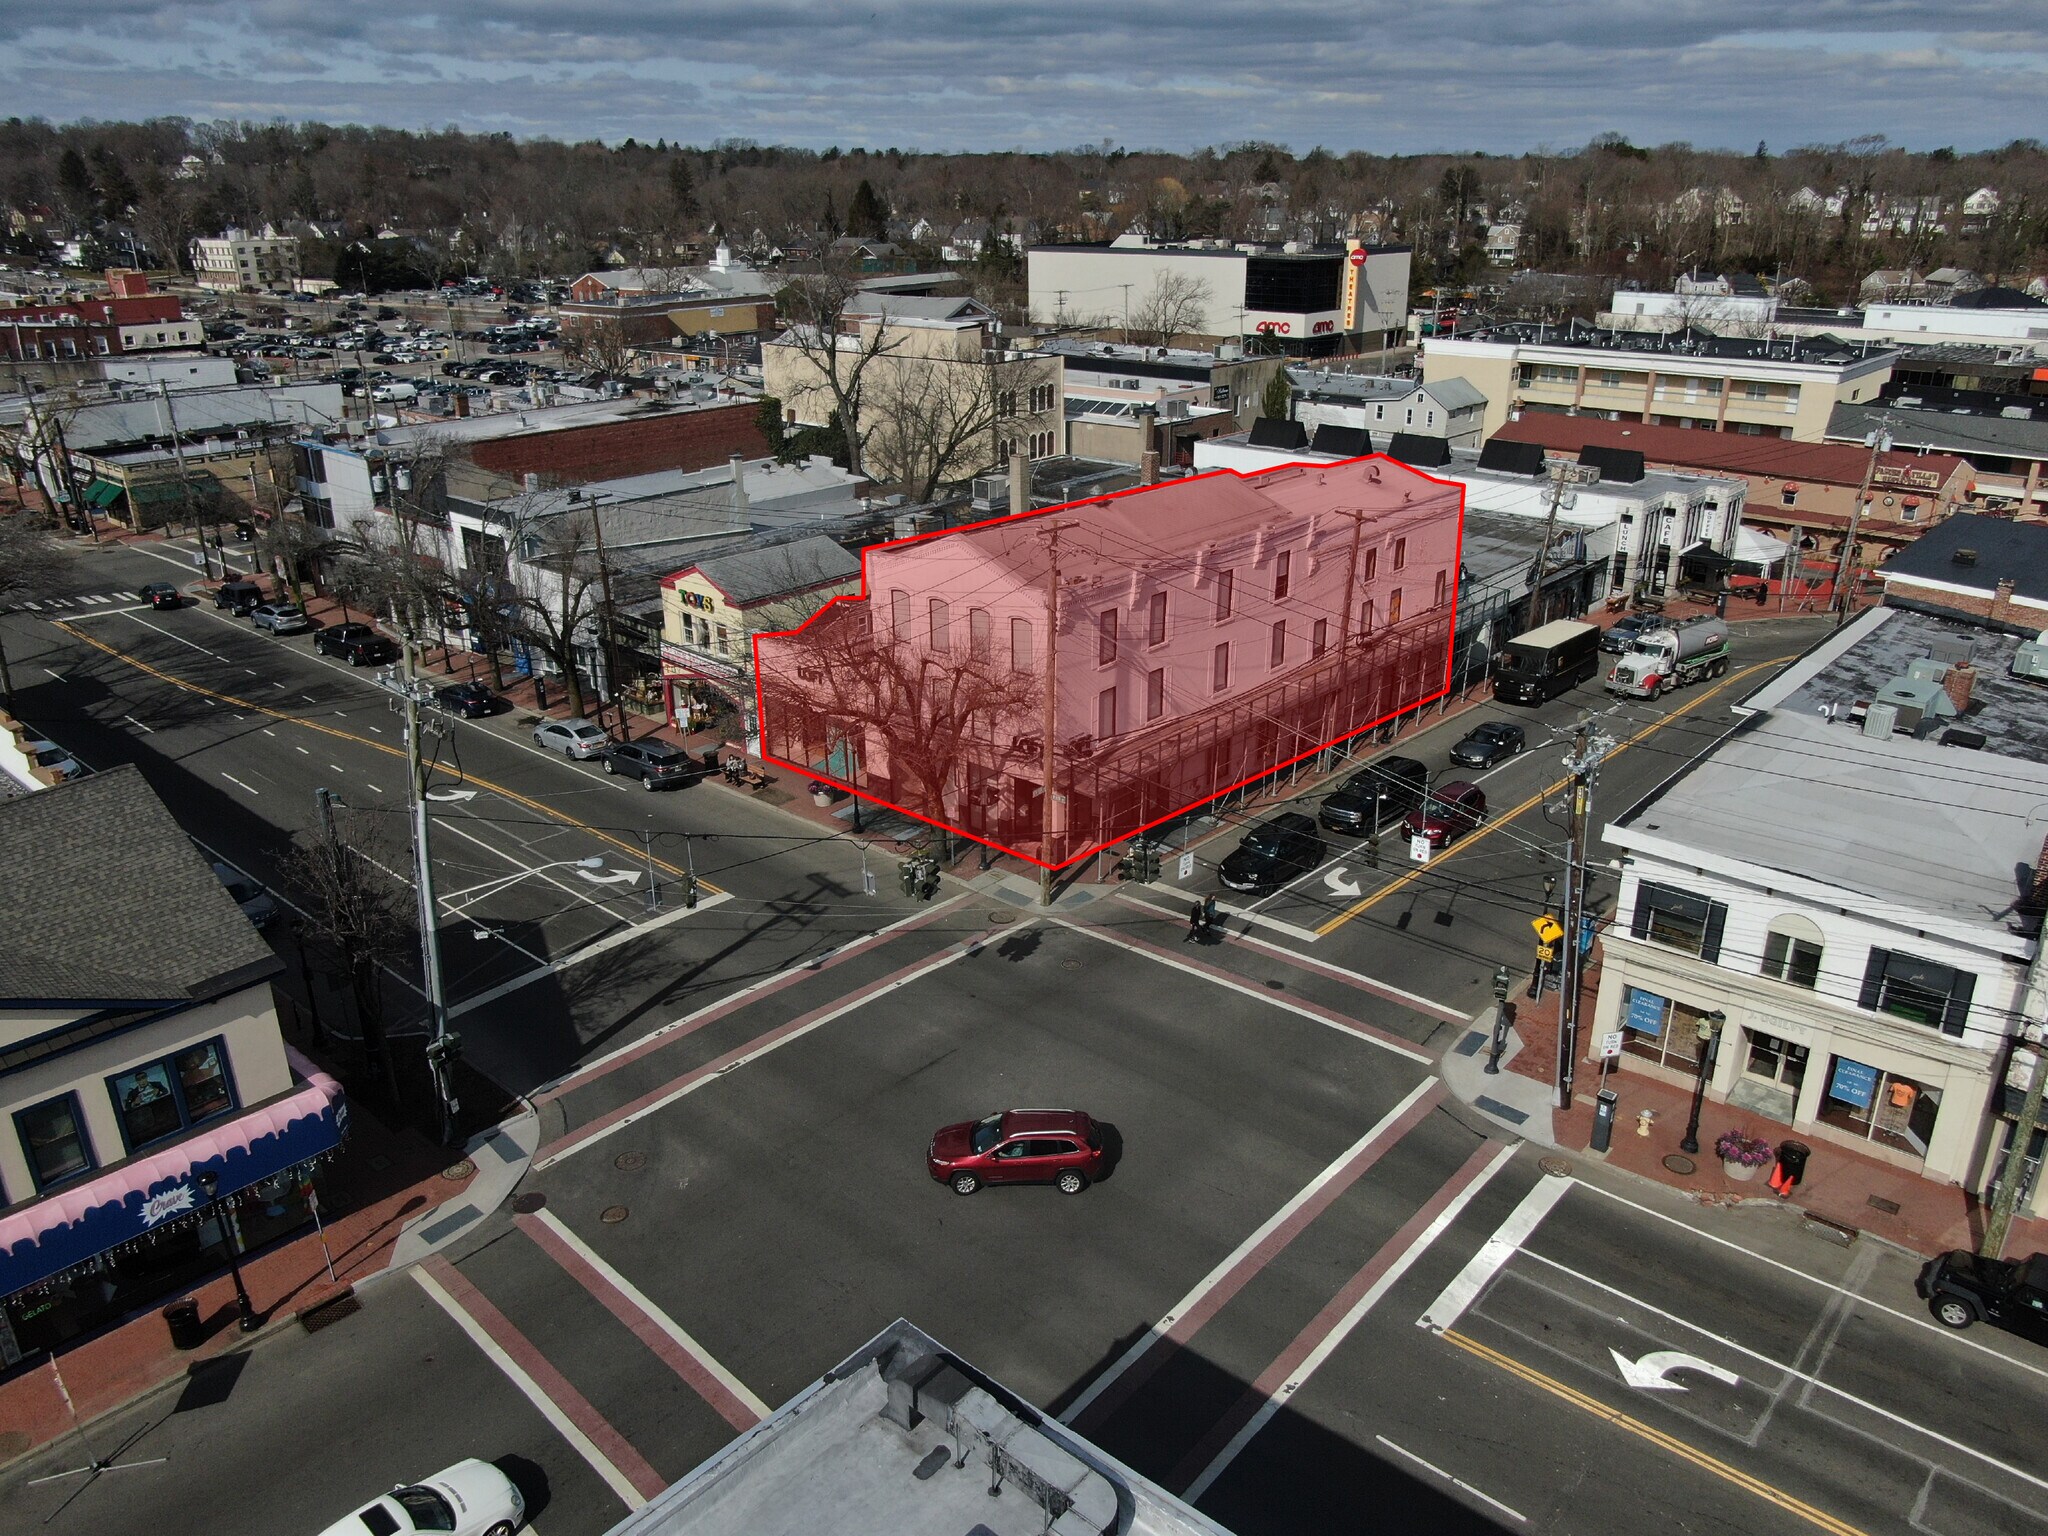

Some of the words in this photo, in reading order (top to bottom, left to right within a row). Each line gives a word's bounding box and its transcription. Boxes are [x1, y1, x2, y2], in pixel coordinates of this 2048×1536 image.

[1345, 269, 1354, 326] THEATRES
[1256, 321, 1291, 334] amc
[1312, 320, 1335, 335] amc
[1663, 517, 1672, 544] CAFE
[1704, 511, 1712, 537] COFFEE
[1620, 523, 1629, 551] LUNCH
[678, 588, 714, 614] TOYS
[1538, 947, 1551, 957] 20
[1643, 1017, 1657, 1025] OFF
[1837, 1068, 1872, 1082] CLEARANCE
[1847, 1066, 1864, 1074] FINAL
[1835, 1083, 1850, 1092] 70%
[1850, 1088, 1867, 1097] OFF
[150, 1192, 185, 1217] Crave
[21, 1302, 52, 1321] GELATO
